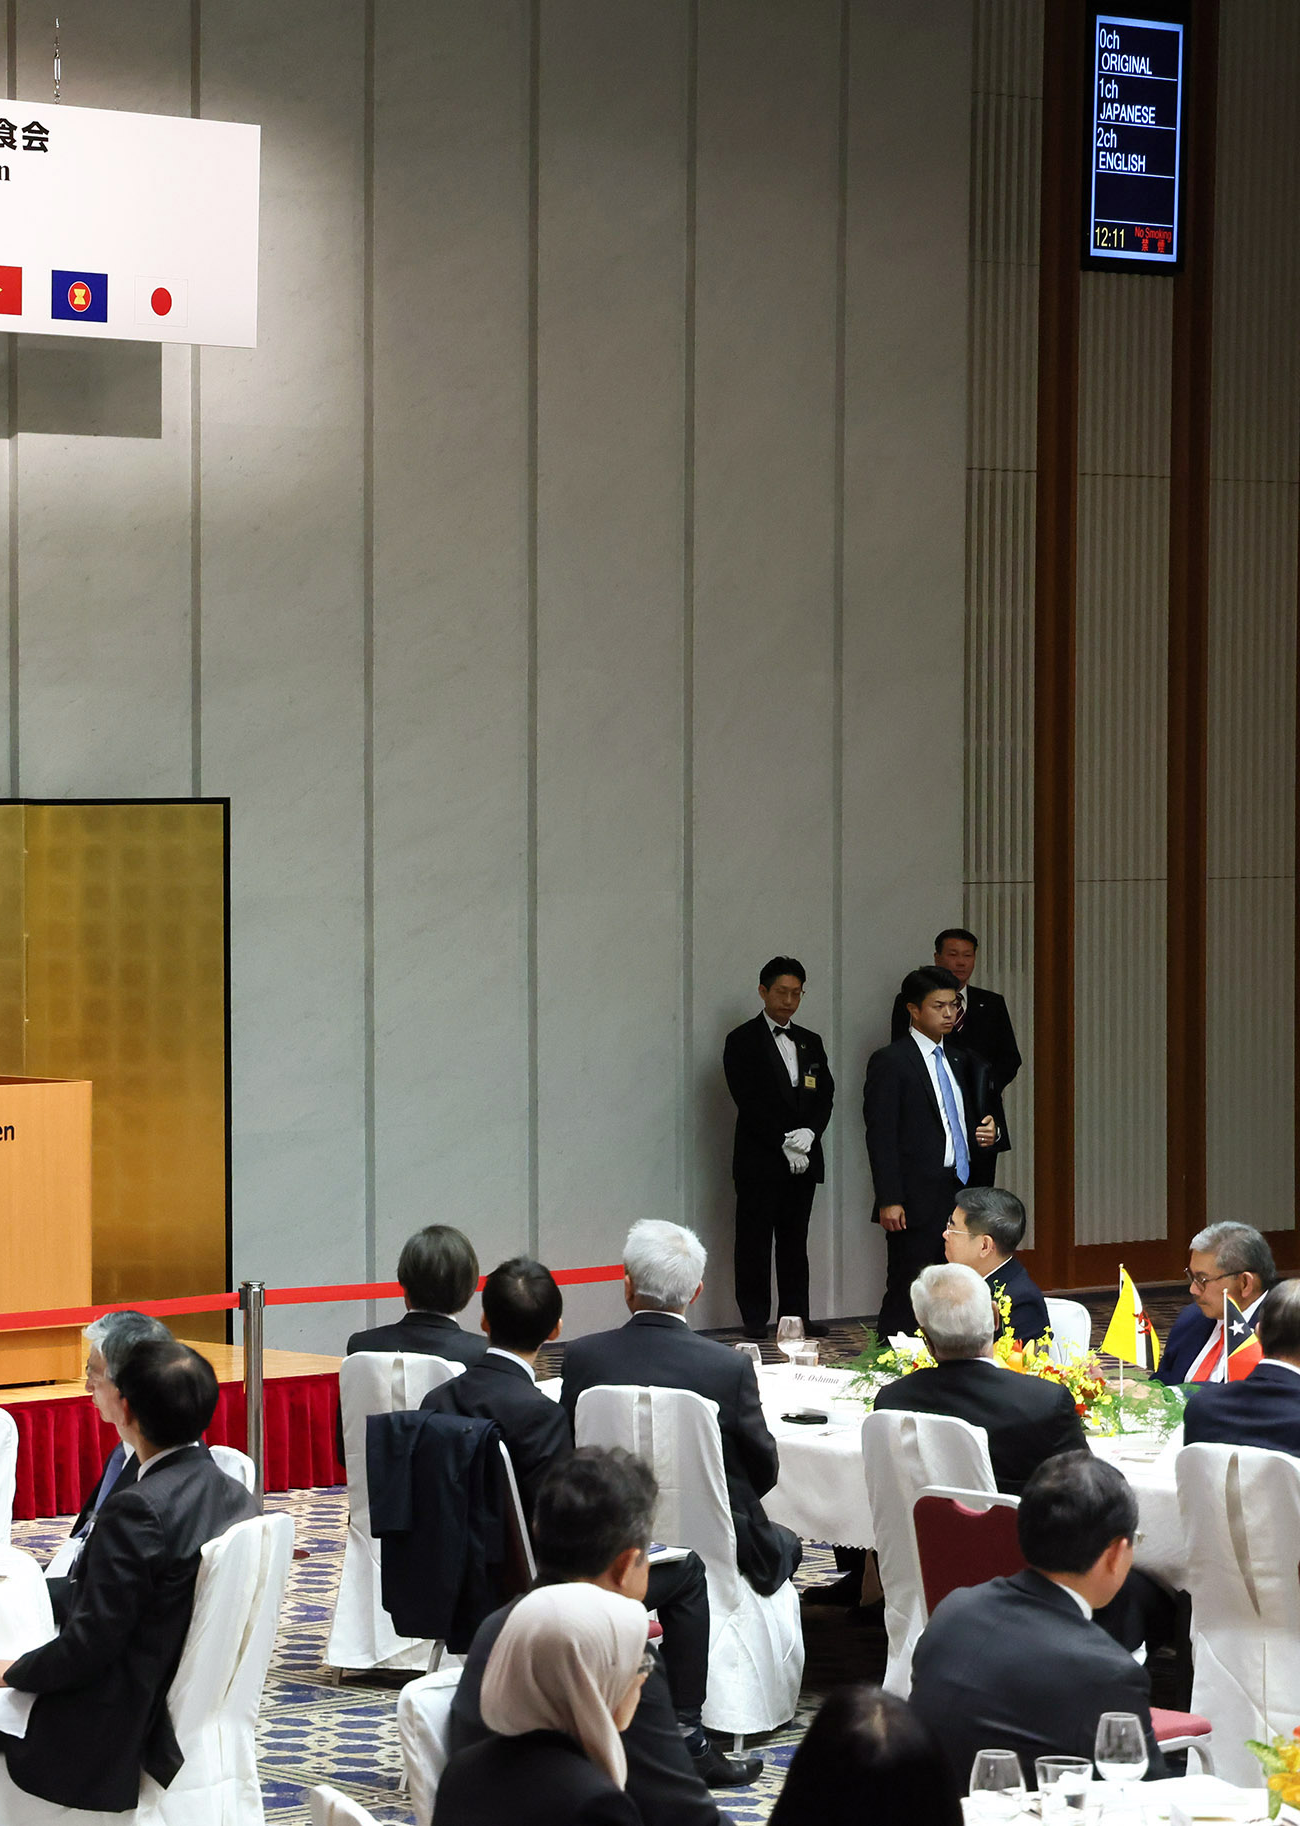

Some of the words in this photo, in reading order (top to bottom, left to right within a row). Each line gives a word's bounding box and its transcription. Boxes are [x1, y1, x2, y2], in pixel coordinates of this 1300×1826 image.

[1099, 28, 1120, 50] 0ch
[1101, 53, 1153, 75] ORIGINAL
[1099, 79, 1119, 99] 1ch
[1100, 102, 1156, 124] JAPANESE
[1097, 127, 1117, 148] 2ch
[1099, 152, 1146, 173] ENGLISH
[1095, 227, 1125, 249] 12:11
[1134, 226, 1144, 238] No
[1145, 227, 1172, 243] Smoking
